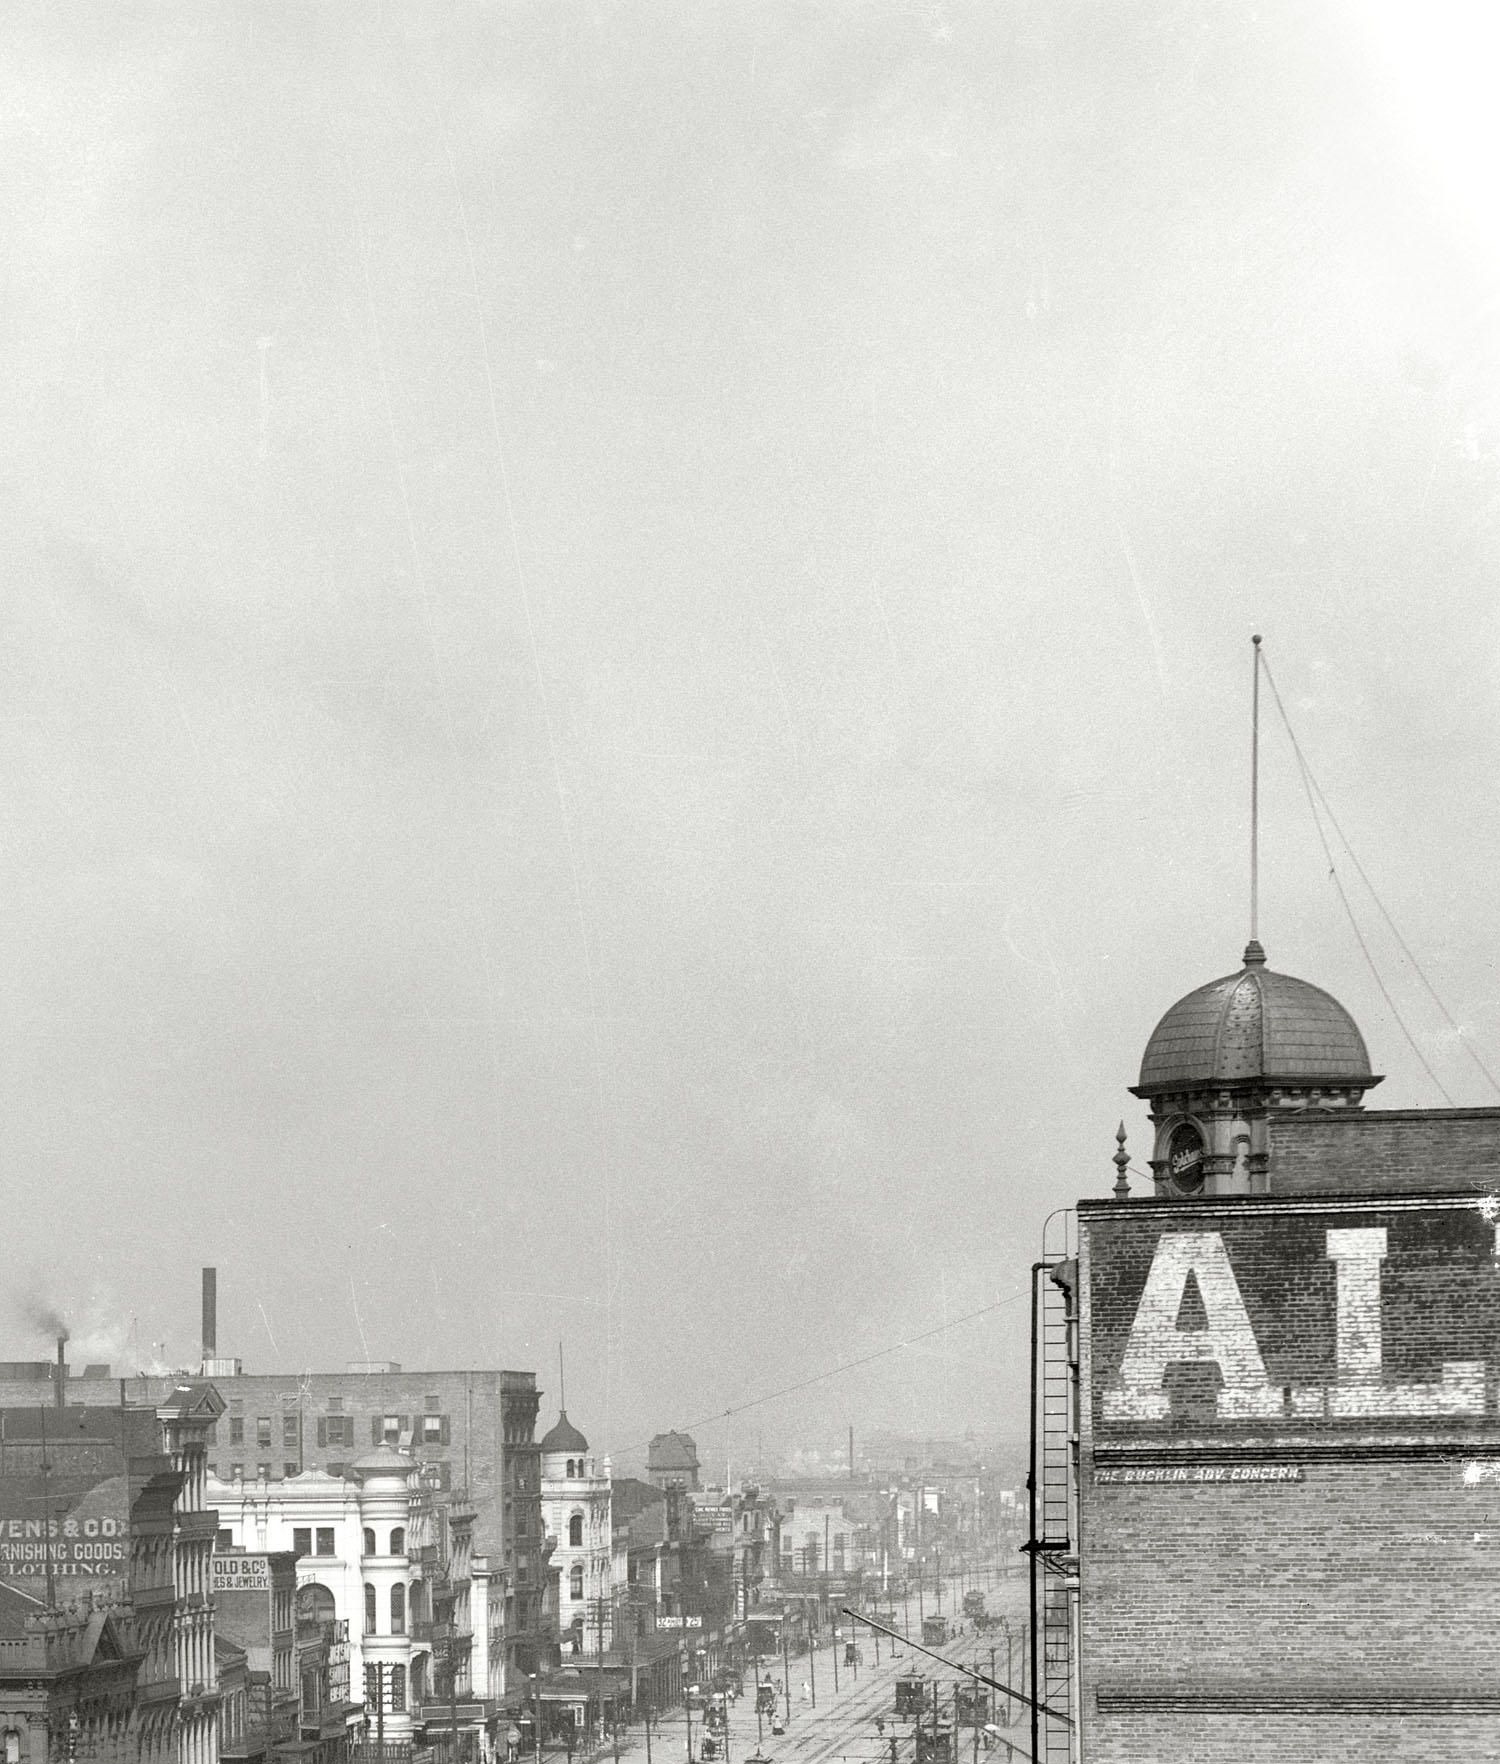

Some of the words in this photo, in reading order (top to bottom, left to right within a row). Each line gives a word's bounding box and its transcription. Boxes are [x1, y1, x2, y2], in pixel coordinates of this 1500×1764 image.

[1125, 1469, 1187, 1481] BUCKLIN
[1194, 1468, 1227, 1480] ADV.
[74, 1543, 126, 1560] GOODS.
[242, 1561, 250, 1574] &
